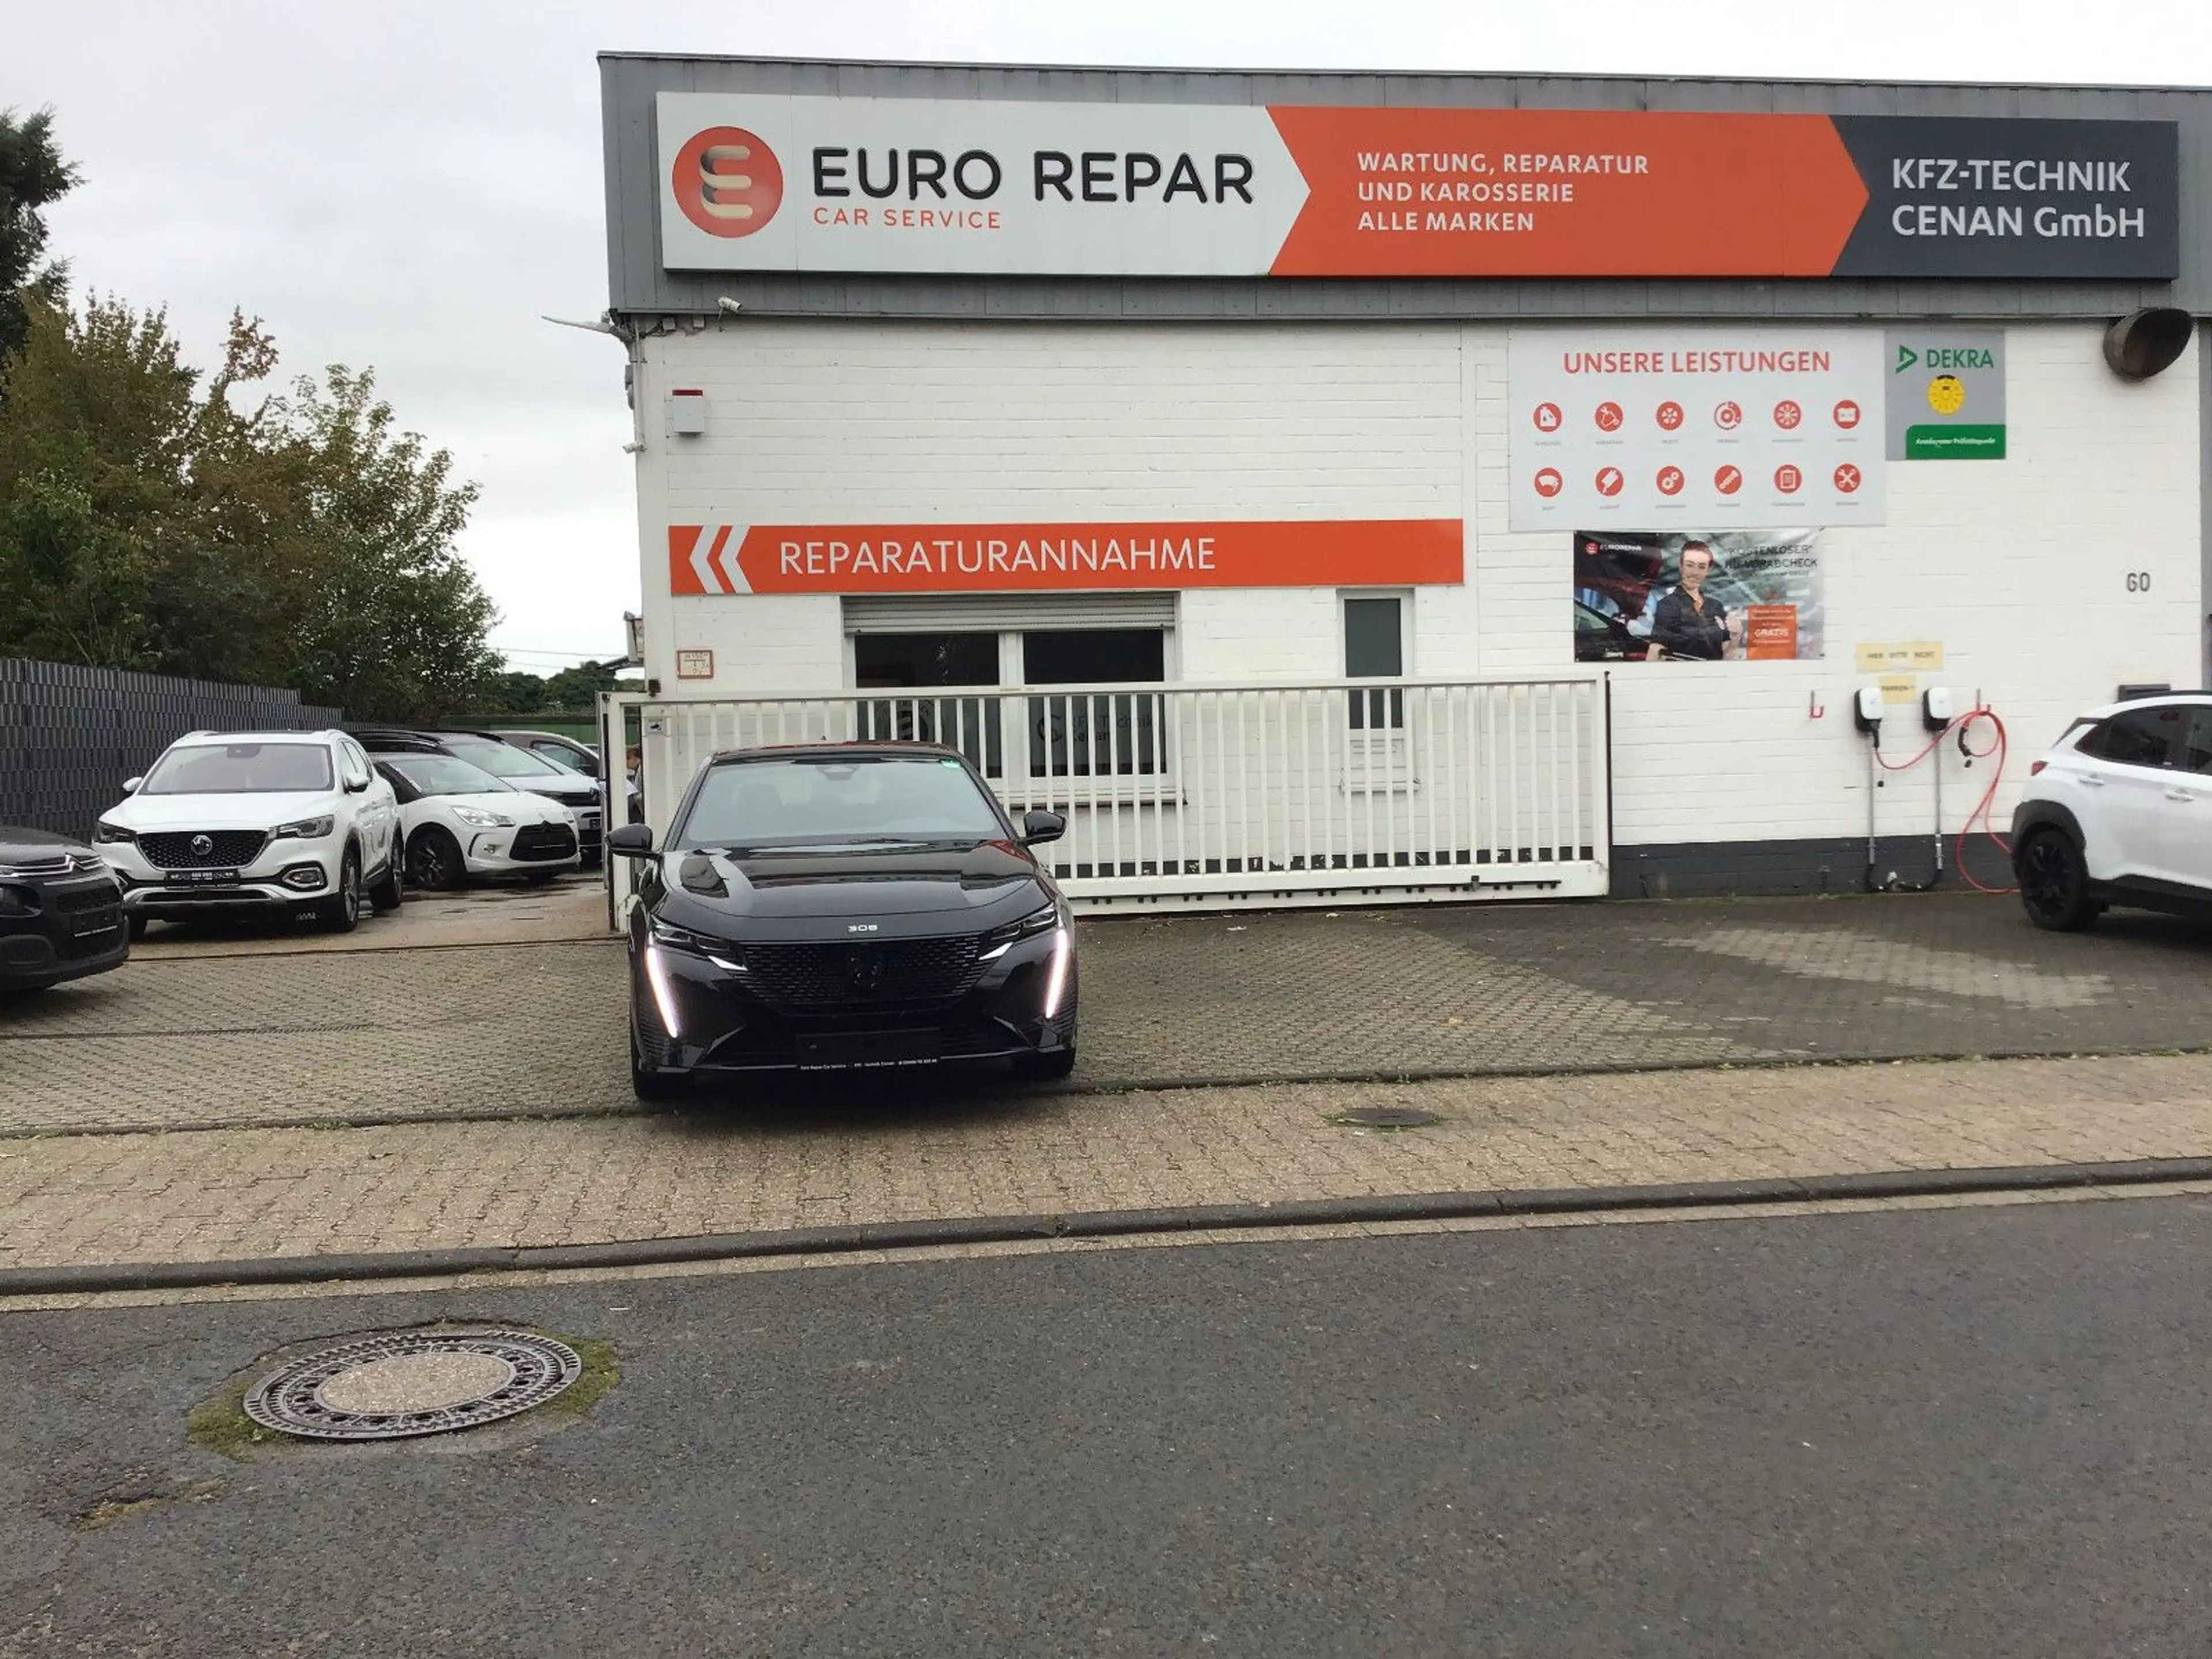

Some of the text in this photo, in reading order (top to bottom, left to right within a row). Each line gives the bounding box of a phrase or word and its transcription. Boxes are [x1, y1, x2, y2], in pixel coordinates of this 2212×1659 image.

[813, 146, 1254, 203] EURO REPAR
[1358, 153, 1649, 175] WARTUNG, REPARATUR
[1893, 159, 2131, 191] KFZ-TECHNIK
[1358, 183, 1573, 202] UND KAROSSERIE
[813, 207, 1001, 229] CAR SERVICE
[1358, 211, 1533, 230] ALLE MARKEN
[1892, 203, 2144, 237] CENAN GmbH
[1563, 351, 1830, 374] UNSERE LEISTUNGEN
[1926, 349, 1994, 369] DEKRA
[781, 537, 1215, 575] REPARATURANNAHME
